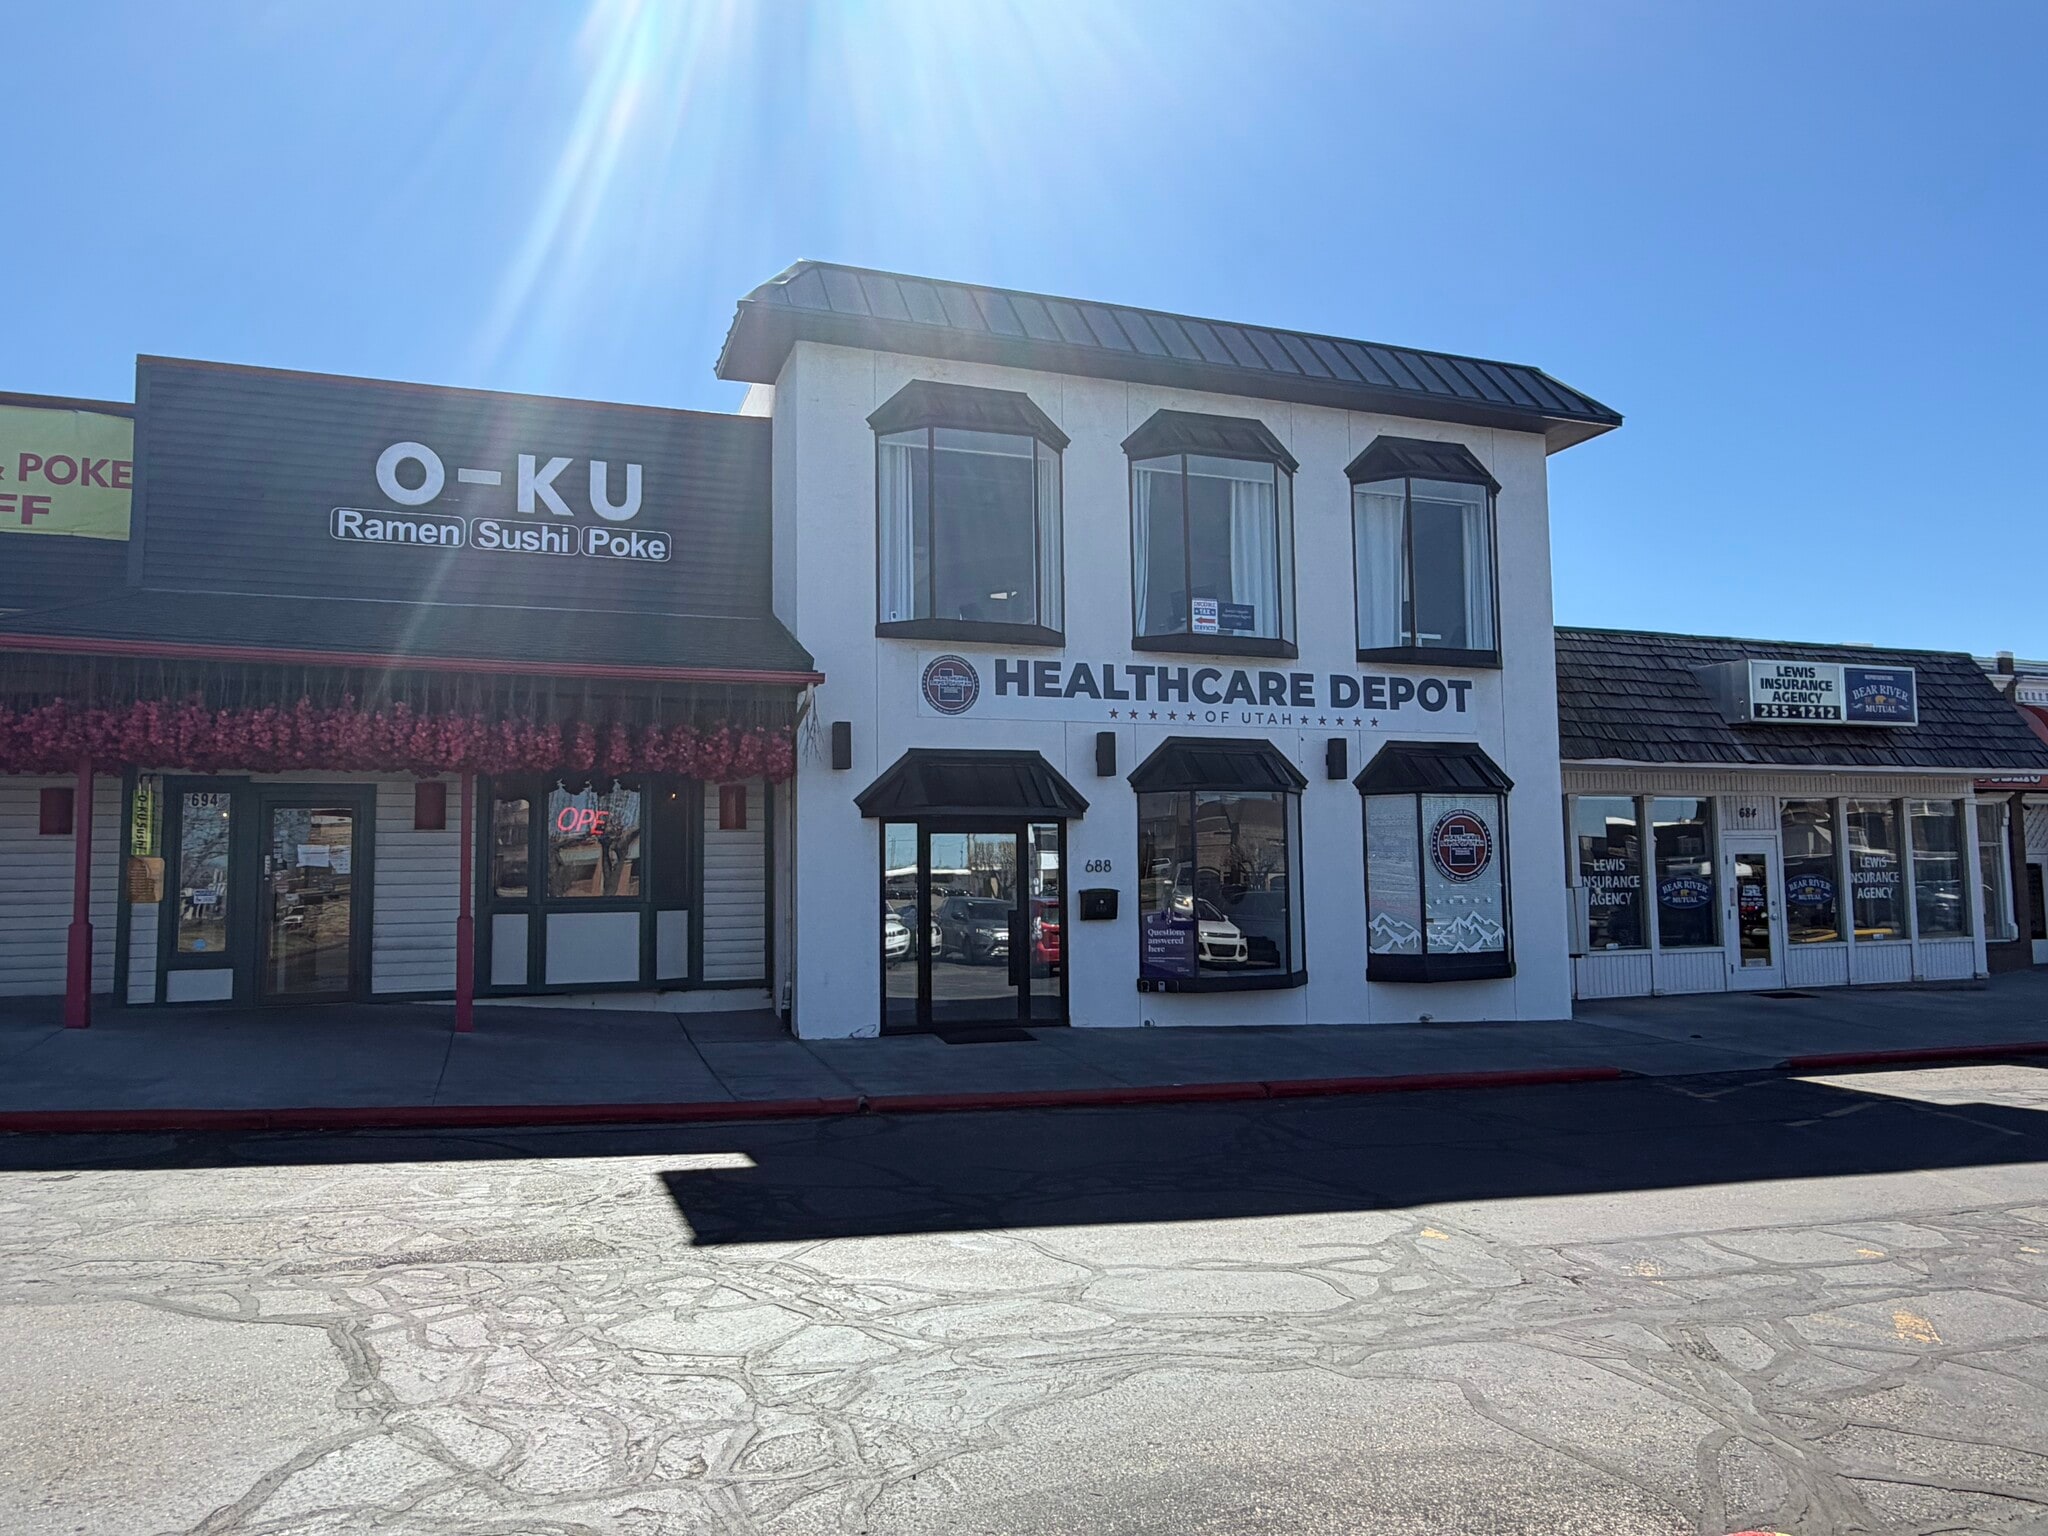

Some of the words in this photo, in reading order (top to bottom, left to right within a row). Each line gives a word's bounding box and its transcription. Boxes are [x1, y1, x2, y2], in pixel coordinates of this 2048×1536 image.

[18, 452, 133, 490] POKE
[376, 441, 643, 521] O-KU
[337, 509, 460, 546] Ramen
[478, 521, 569, 553] Sushi
[588, 529, 666, 560] Poke
[1776, 666, 1816, 679] LEWIS
[995, 659, 1316, 707] HEALTHCARE
[1330, 674, 1473, 713] DEPOT
[1760, 678, 1833, 692] INSURANCE
[1772, 691, 1823, 704] AGENCY
[1852, 685, 1879, 700] BEAR
[1879, 685, 1909, 702] RIVER
[1865, 705, 1897, 714] MUTUAL
[1205, 711, 1230, 724] OF
[1241, 712, 1292, 726] UTAH
[191, 793, 218, 807] 694
[1739, 807, 1757, 819] 684
[1085, 859, 1112, 873] 688
[1593, 859, 1626, 872] LEWIS
[1860, 856, 1887, 868] LEWIS
[1581, 875, 1641, 889] NSURANCE
[1850, 871, 1900, 883] NSURANCE
[1662, 880, 1682, 894] BEAR
[1683, 880, 1709, 893] RIVER
[1788, 879, 1808, 891] BEAR
[1808, 879, 1831, 891] RIVER
[1590, 892, 1632, 905] AGENCY
[1857, 887, 1893, 899] AGENCY
[1672, 896, 1698, 904] MUTUAL
[1147, 928, 1186, 937] Questions
[1148, 945, 1165, 953] here
